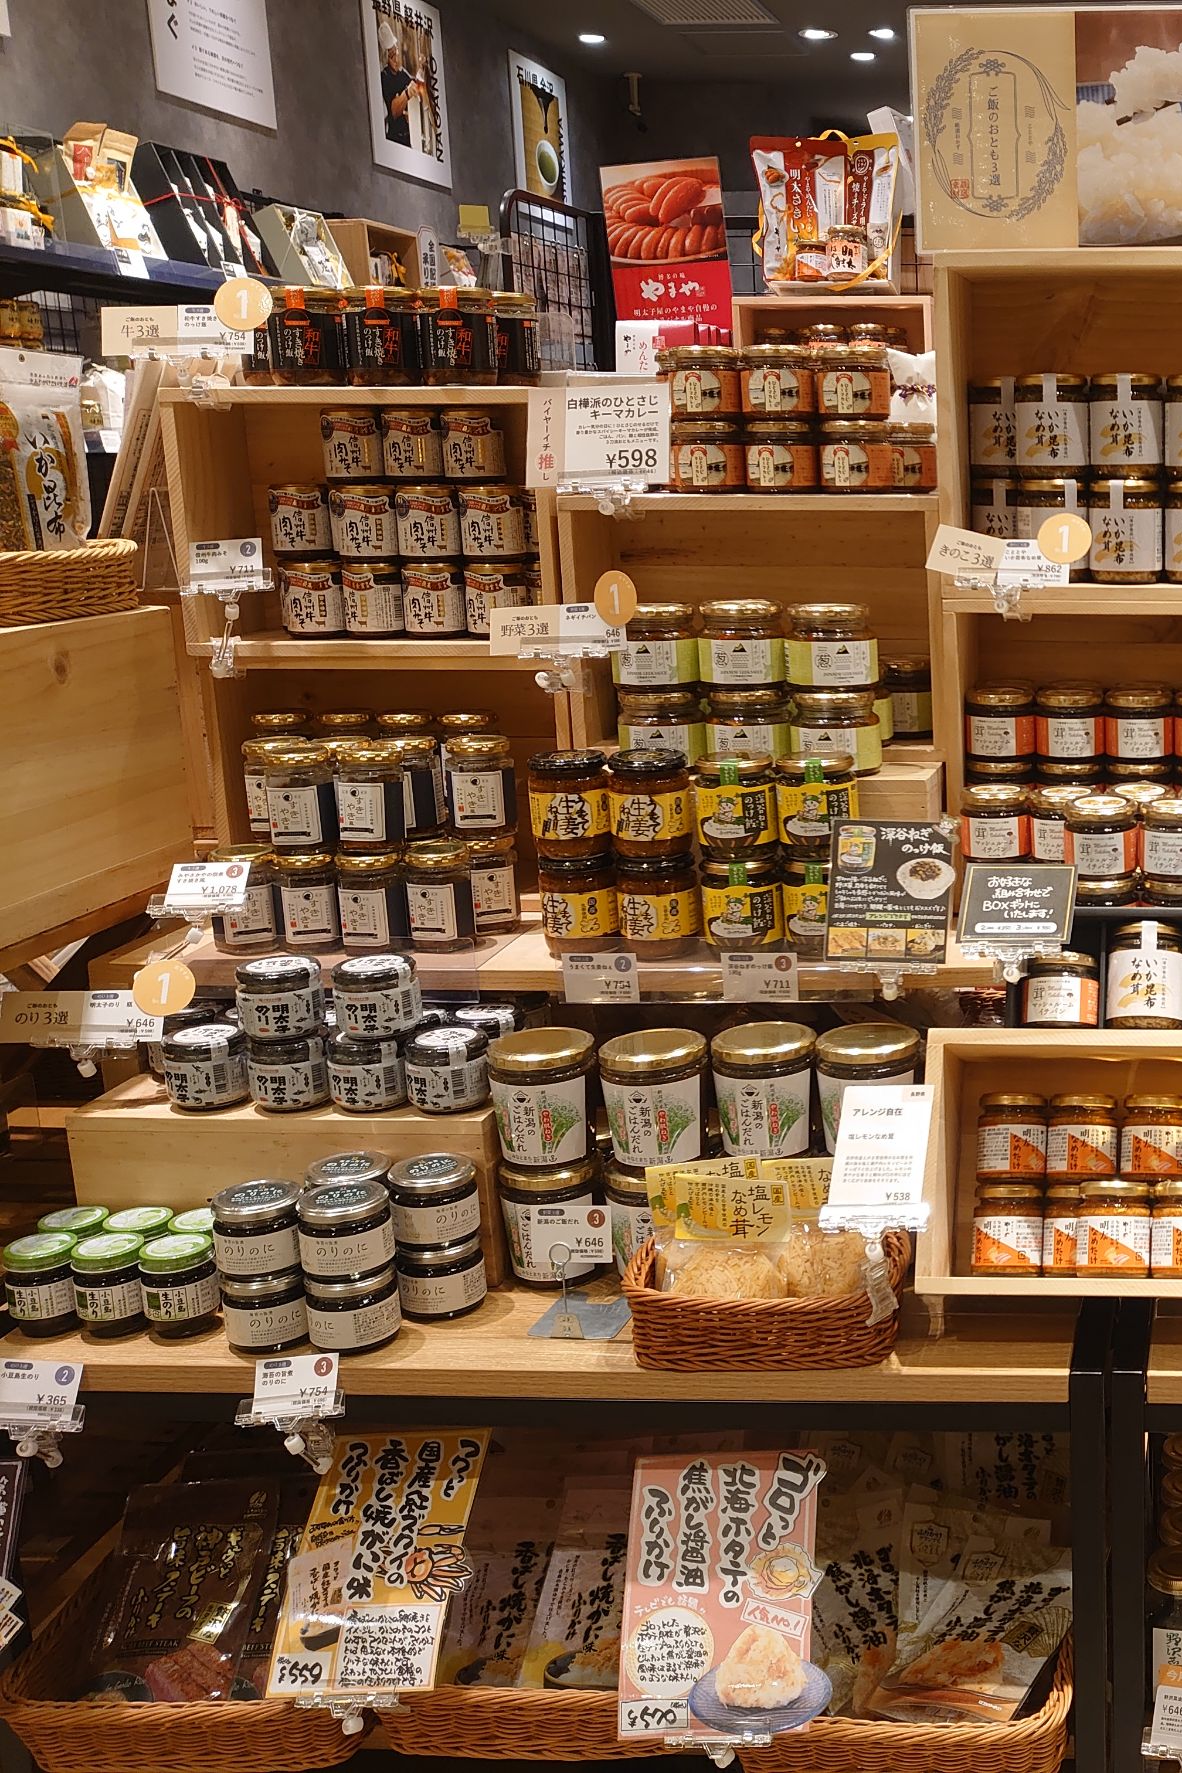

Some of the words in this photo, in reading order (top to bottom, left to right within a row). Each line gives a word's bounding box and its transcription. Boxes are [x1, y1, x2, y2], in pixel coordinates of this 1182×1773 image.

[427, 56, 444, 163] NAGANO
[986, 87, 1000, 187] ご飯のおとも3選
[640, 279, 700, 302] やまや
[121, 324, 160, 338] 牛3選
[567, 395, 659, 410] 白樺派のひとさじ
[589, 409, 659, 420] キーマカレー
[1047, 410, 1060, 459] いか昆布
[605, 448, 657, 469] ¥598
[939, 544, 995, 568] きのこ3選
[608, 583, 620, 615] 1
[500, 622, 549, 637] 野菜3選
[606, 628, 621, 638] 646
[880, 826, 934, 846] 深谷ねぎ
[901, 842, 951, 856] のっけ飯
[987, 875, 1033, 888] お好きな
[992, 886, 1054, 899] 組み合わせで
[764, 980, 791, 989] ¥711
[1131, 957, 1142, 995] なめ茸
[1145, 958, 1158, 1008] いか昆布
[155, 973, 171, 1004] 1
[14, 1010, 69, 1025] のり3選
[126, 1018, 155, 1028] ¥646
[271, 1003, 289, 1034] 明太子
[361, 1003, 379, 1034] 明太子
[523, 1105, 536, 1138] 新潟の
[639, 1105, 652, 1138] 新潟の
[852, 1107, 904, 1117] アレンジ自在
[513, 1105, 527, 1154] ごはんだれ
[628, 1105, 643, 1154] ごはんだれ
[885, 1192, 911, 1201] ¥538
[592, 1213, 600, 1225] 3
[730, 1188, 750, 1239] なめ茸
[747, 1185, 772, 1238] 塩レモン
[225, 1241, 275, 1258] のりのに
[316, 1240, 369, 1257] のりのに
[575, 1237, 604, 1248] ¥646
[62, 1370, 69, 1382] 2
[319, 1360, 328, 1372] 3
[36, 1394, 67, 1406] ¥365
[299, 1386, 328, 1398] ¥754
[331, 1442, 369, 1516] ふりかけ
[642, 1487, 673, 1583] ふりかけ
[678, 1463, 711, 1590] 焦がし醤油
[720, 1465, 753, 1606] 北海ホタテの
[627, 1704, 678, 1729] ¥570
